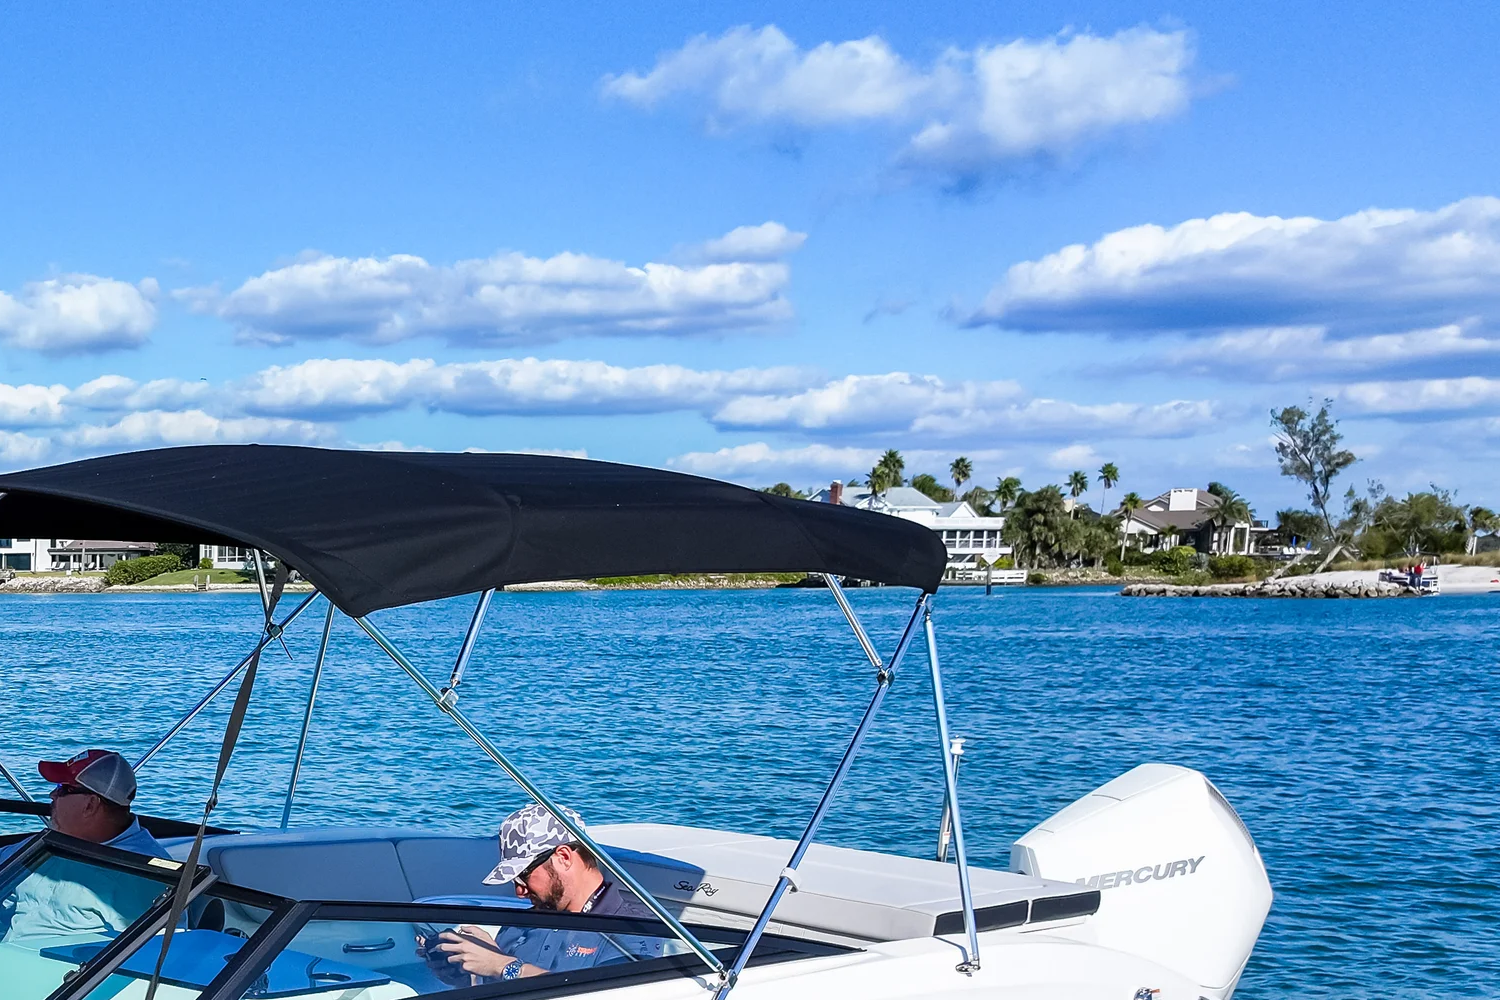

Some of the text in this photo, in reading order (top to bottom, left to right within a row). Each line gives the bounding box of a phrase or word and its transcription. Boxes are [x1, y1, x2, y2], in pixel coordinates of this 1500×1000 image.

[1076, 855, 1206, 889] MERCURY
[673, 880, 720, 897] Sea Ray
